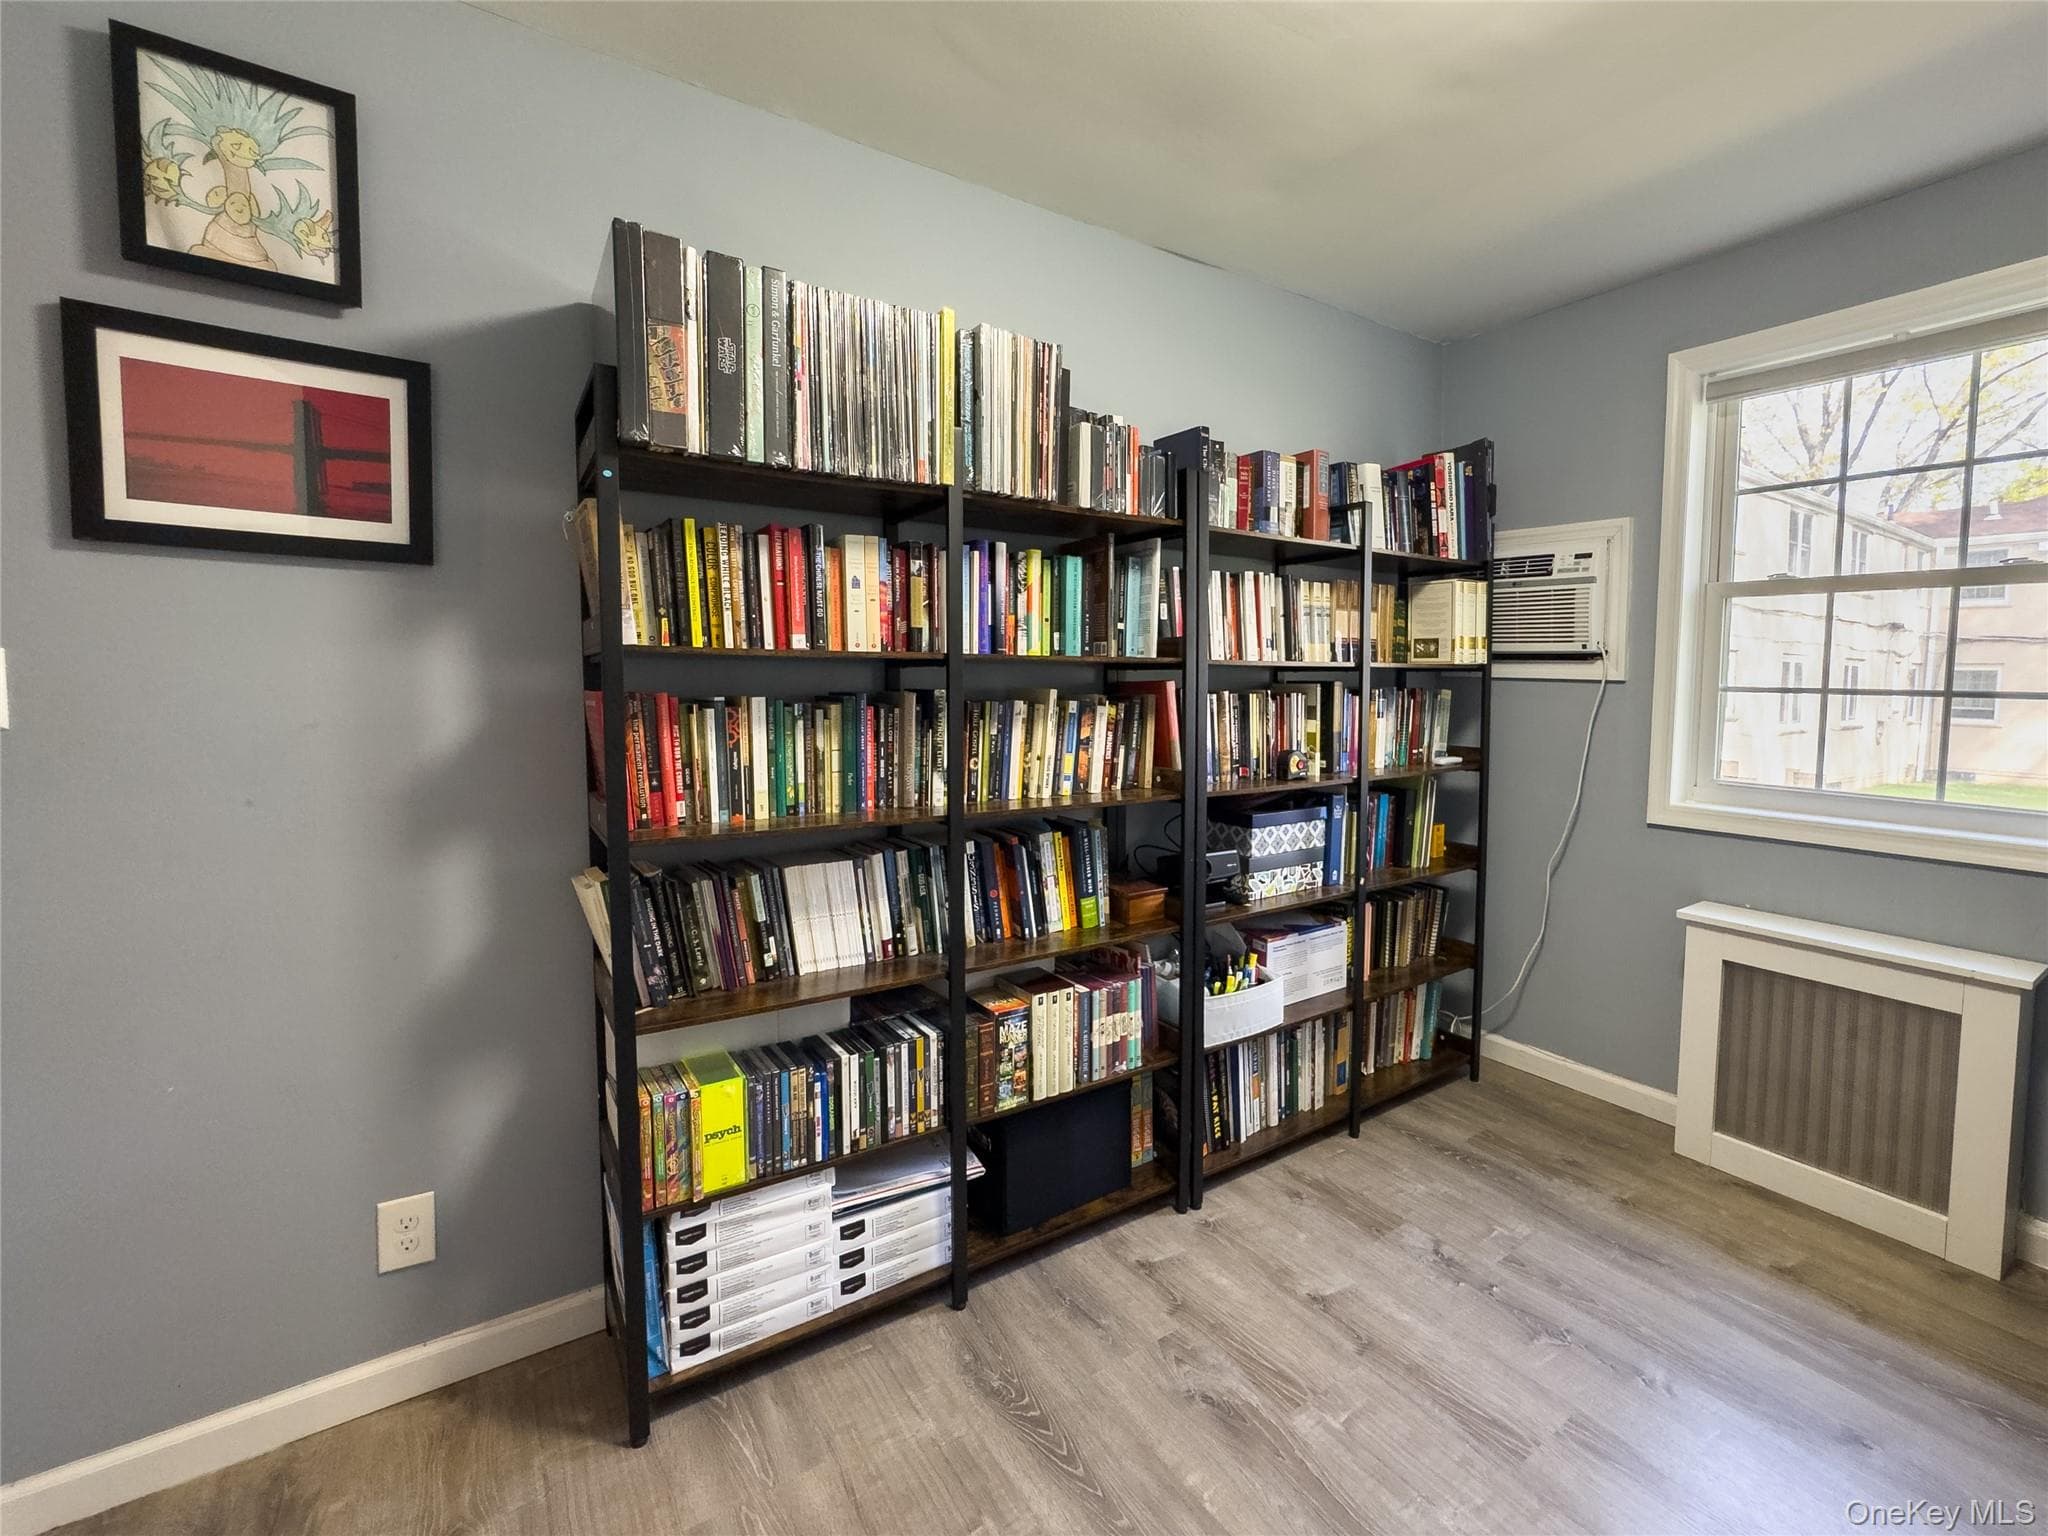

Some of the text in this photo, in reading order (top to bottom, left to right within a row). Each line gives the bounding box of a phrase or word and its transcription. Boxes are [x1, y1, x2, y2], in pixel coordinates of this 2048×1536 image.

[771, 278, 781, 309] Simon
[717, 337, 728, 373] WARS
[726, 338, 737, 374] STAR
[771, 320, 782, 368] Garfunkel
[626, 556, 635, 565] NO
[774, 531, 783, 571] REPARATIONS
[814, 551, 822, 564] THE
[627, 566, 637, 579] GOD
[705, 541, 721, 618] COLOR COMPROMISE
[719, 522, 732, 612] READING WHILE BLACK
[815, 564, 823, 589] CHINESE
[816, 608, 824, 618] GO
[935, 712, 943, 747] WITHOUT
[1105, 730, 1113, 760] APOLOGETICS
[632, 719, 647, 809] the permanent revolution
[676, 771, 684, 794] CHURCH
[1083, 838, 1092, 878] WELL-TRAINED
[644, 898, 656, 923] SINGING
[652, 929, 660, 942] THE
[654, 941, 664, 958] DARK
[694, 947, 704, 967] Lewis
[999, 1019, 1029, 1034] MAZE
[999, 1031, 1028, 1045] RUNNER
[703, 1124, 742, 1145] psych
[1213, 1115, 1222, 1139] RICE
